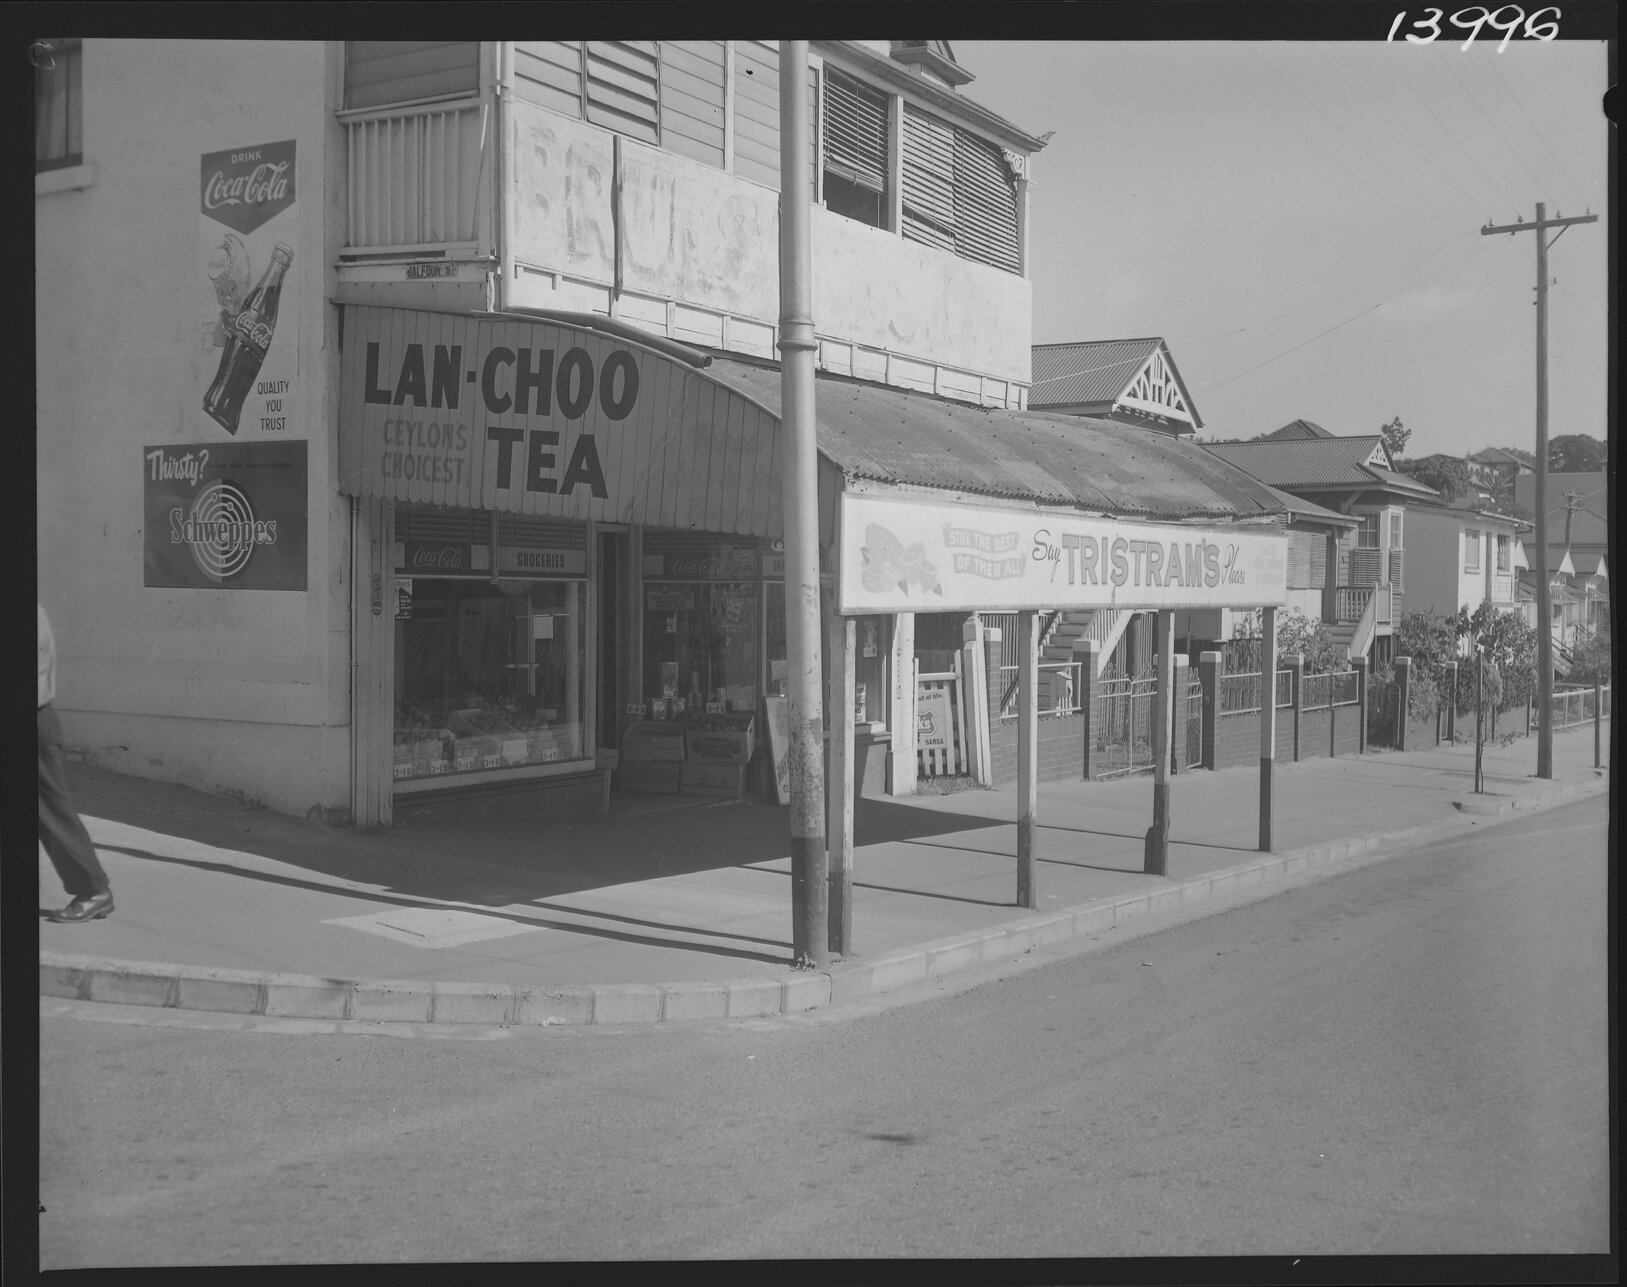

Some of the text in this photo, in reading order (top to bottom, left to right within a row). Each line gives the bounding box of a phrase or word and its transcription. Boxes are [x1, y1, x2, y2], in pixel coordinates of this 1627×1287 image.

[231, 150, 262, 164] DRINK
[204, 161, 291, 209] Coca-Cola
[408, 265, 440, 279] BALFOUR
[257, 380, 290, 395] QUALITY
[365, 341, 640, 421] LAN-CHOO
[265, 399, 282, 413] YOU
[260, 417, 287, 431] TRUST
[383, 418, 467, 451] CEYLON'S
[146, 449, 209, 486] Thirsty?
[487, 426, 609, 499] TEA
[169, 507, 277, 551] Schweppes
[949, 530, 1016, 551] STILL THE BEST
[412, 546, 464, 569] Coca-Cola
[517, 552, 566, 569] GROCERIES
[957, 556, 968, 570] OF
[1005, 560, 1020, 577] ALL
[1032, 529, 1246, 587] Say TRISTRAM'S Please
[925, 738, 944, 746] SARSA
